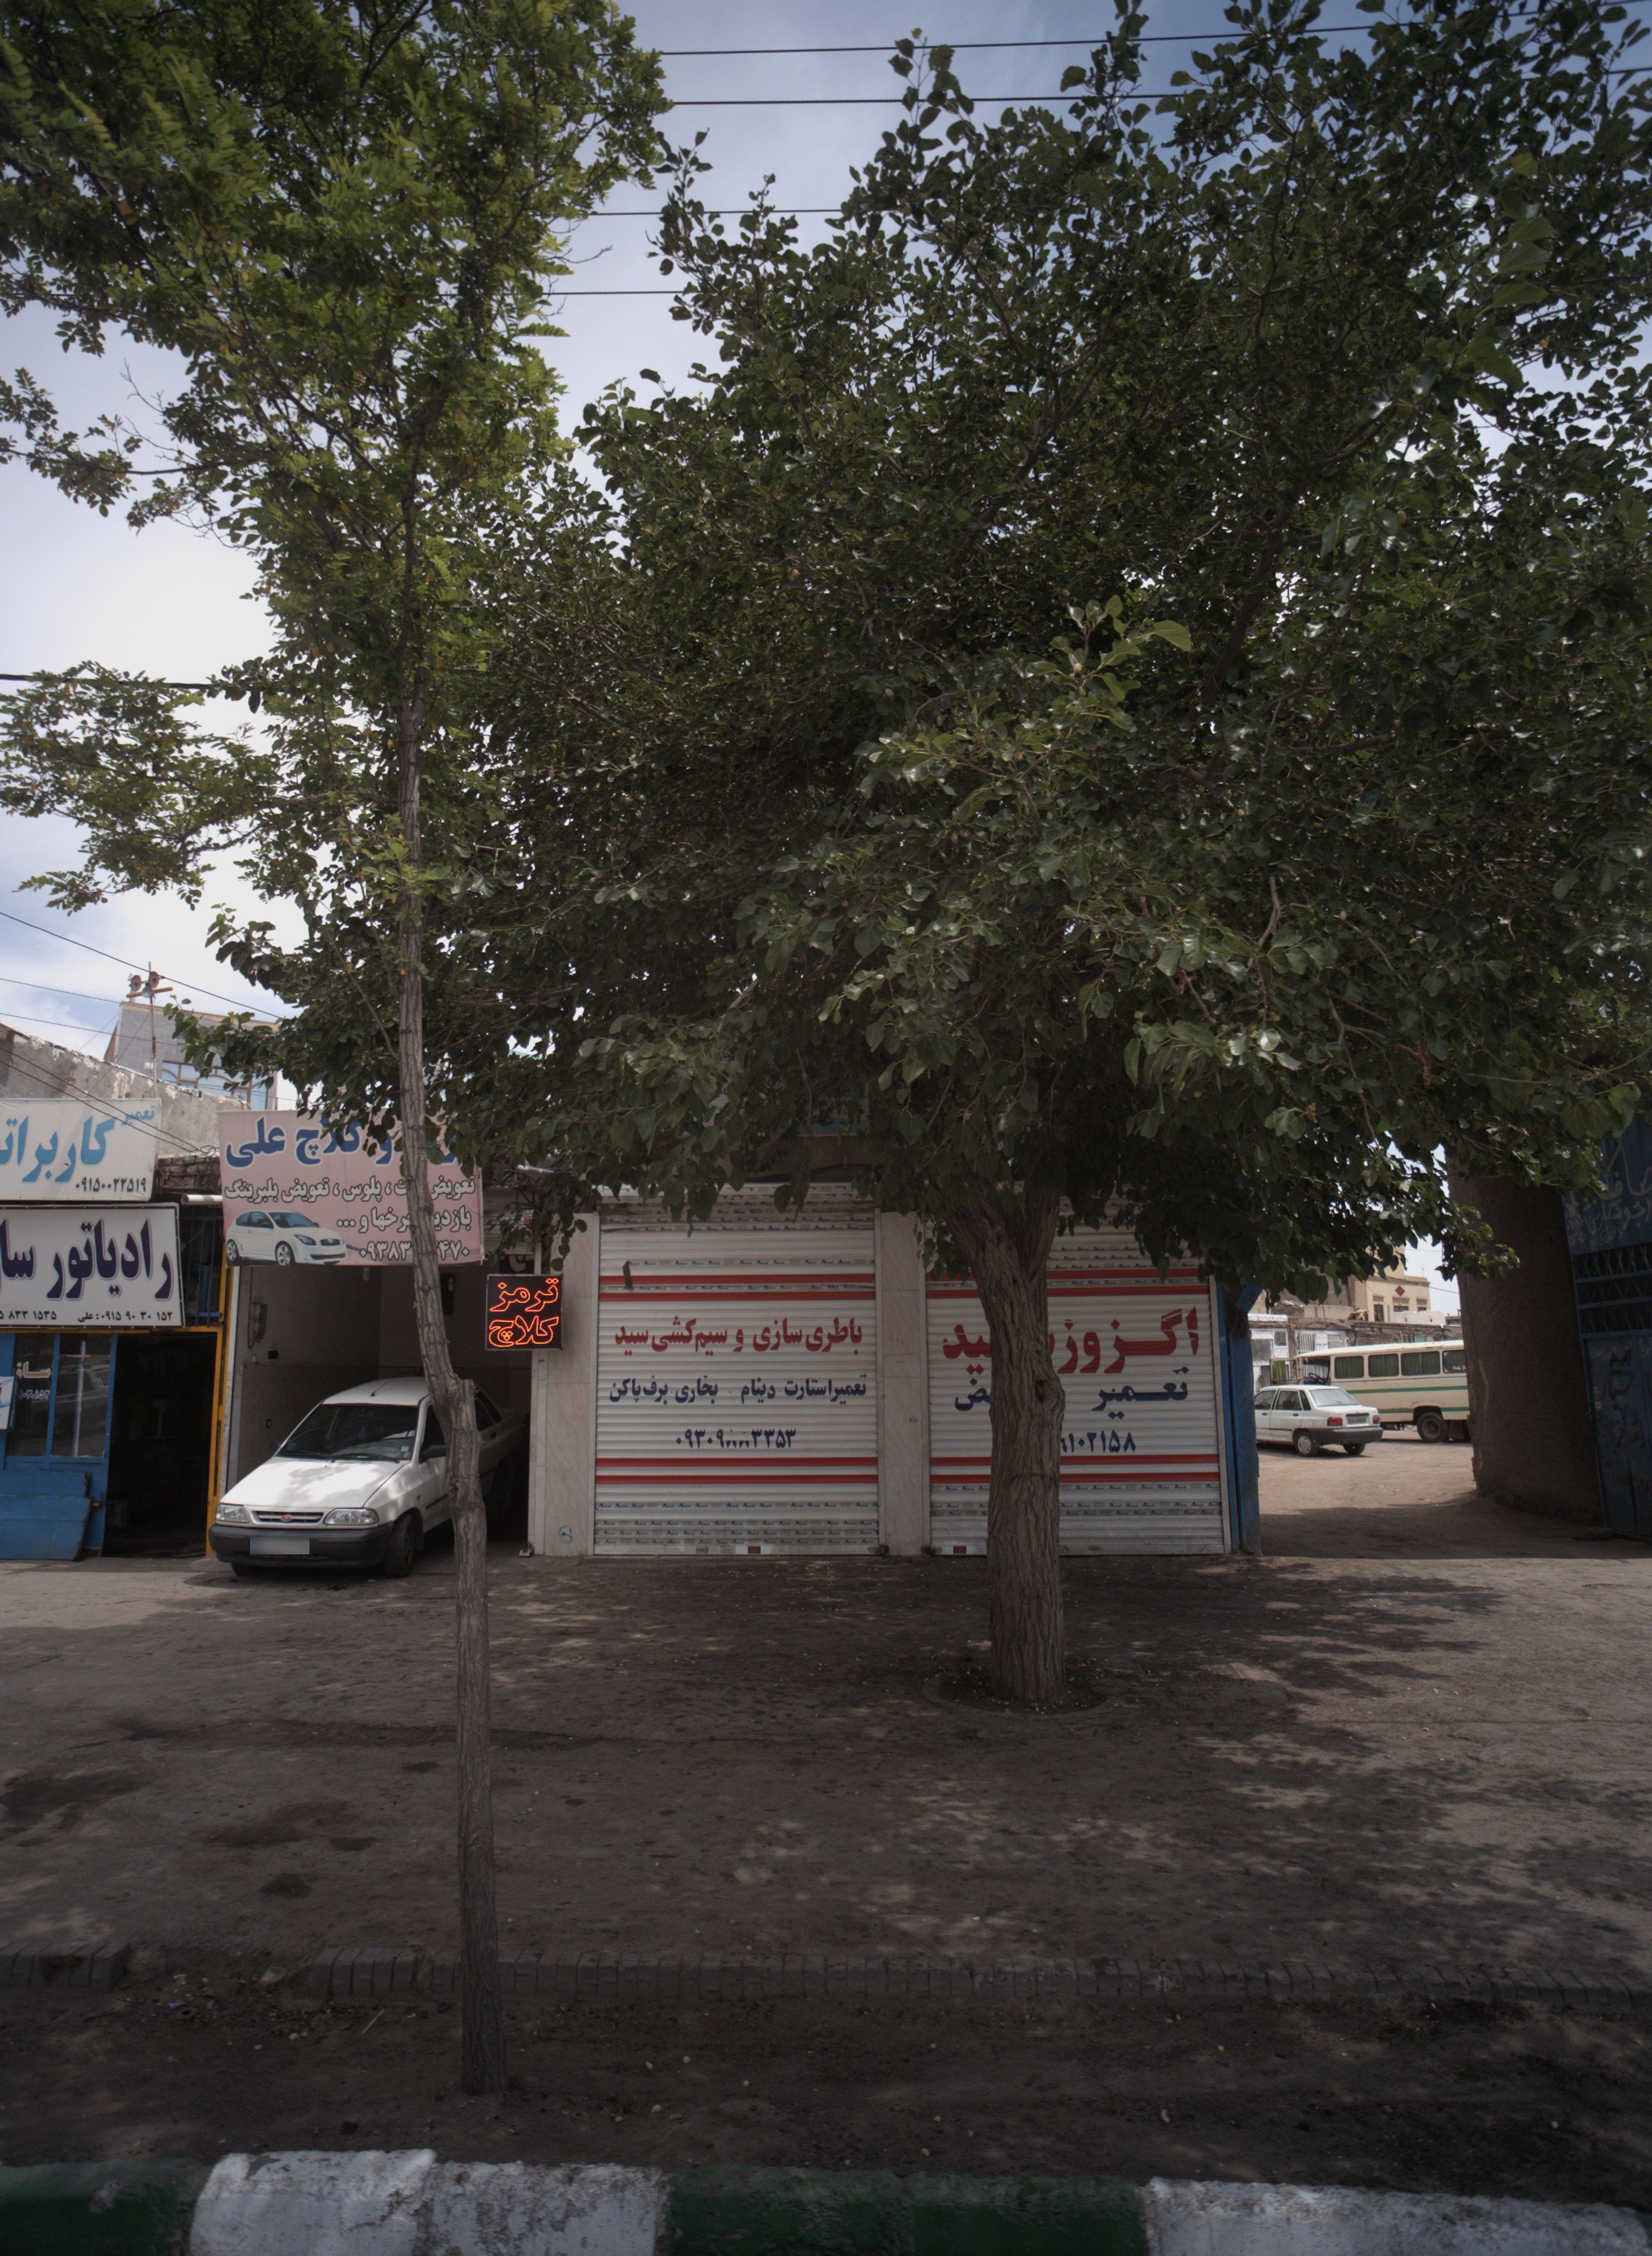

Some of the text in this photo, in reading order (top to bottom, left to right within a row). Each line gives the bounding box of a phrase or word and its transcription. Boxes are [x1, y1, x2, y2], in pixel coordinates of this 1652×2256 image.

[121, 1105, 155, 1125] تعمیر
[226, 1116, 286, 1168] علی
[225, 1177, 279, 1204] بلبرینگ
[281, 1177, 330, 1203] تعویض
[343, 1175, 382, 1202] پلوس
[358, 1214, 368, 1233] و
[47, 1218, 173, 1299] رادیاتور
[359, 1240, 470, 1261] ۰۹۳۸۳۴۷۰
[490, 1278, 559, 1312] ترمز
[489, 1315, 559, 1347] کلاچ
[615, 1326, 649, 1356] سید
[733, 1328, 744, 1352] و
[753, 1317, 802, 1352] سازی
[806, 1317, 862, 1355] باطری
[1057, 1306, 1199, 1374] اگزوز
[675, 1375, 718, 1404] بخاری
[741, 1377, 775, 1404] دینام
[1091, 1366, 1188, 1419] تعمیر
